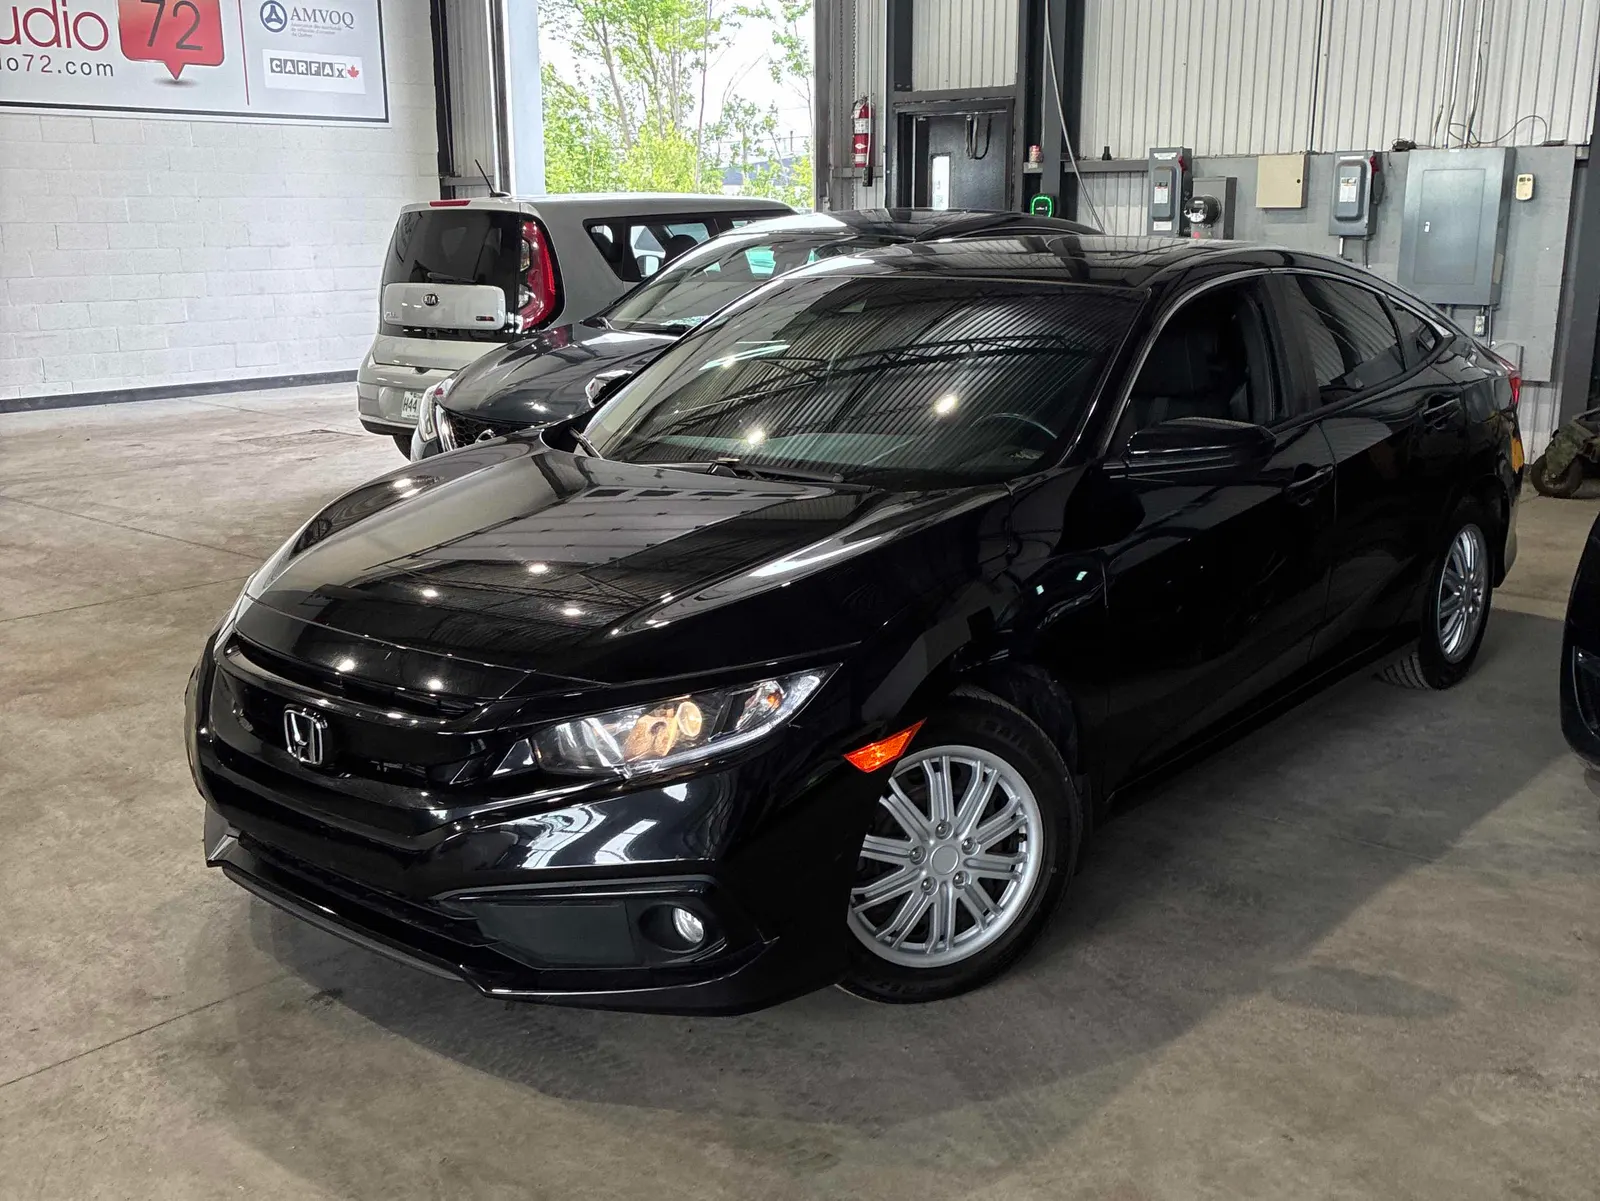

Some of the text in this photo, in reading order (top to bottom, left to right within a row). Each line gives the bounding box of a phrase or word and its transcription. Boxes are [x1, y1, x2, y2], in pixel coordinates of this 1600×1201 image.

[141, 0, 203, 50] 72
[290, 7, 355, 29] AMVOQ
[270, 57, 346, 78] CARFAX
